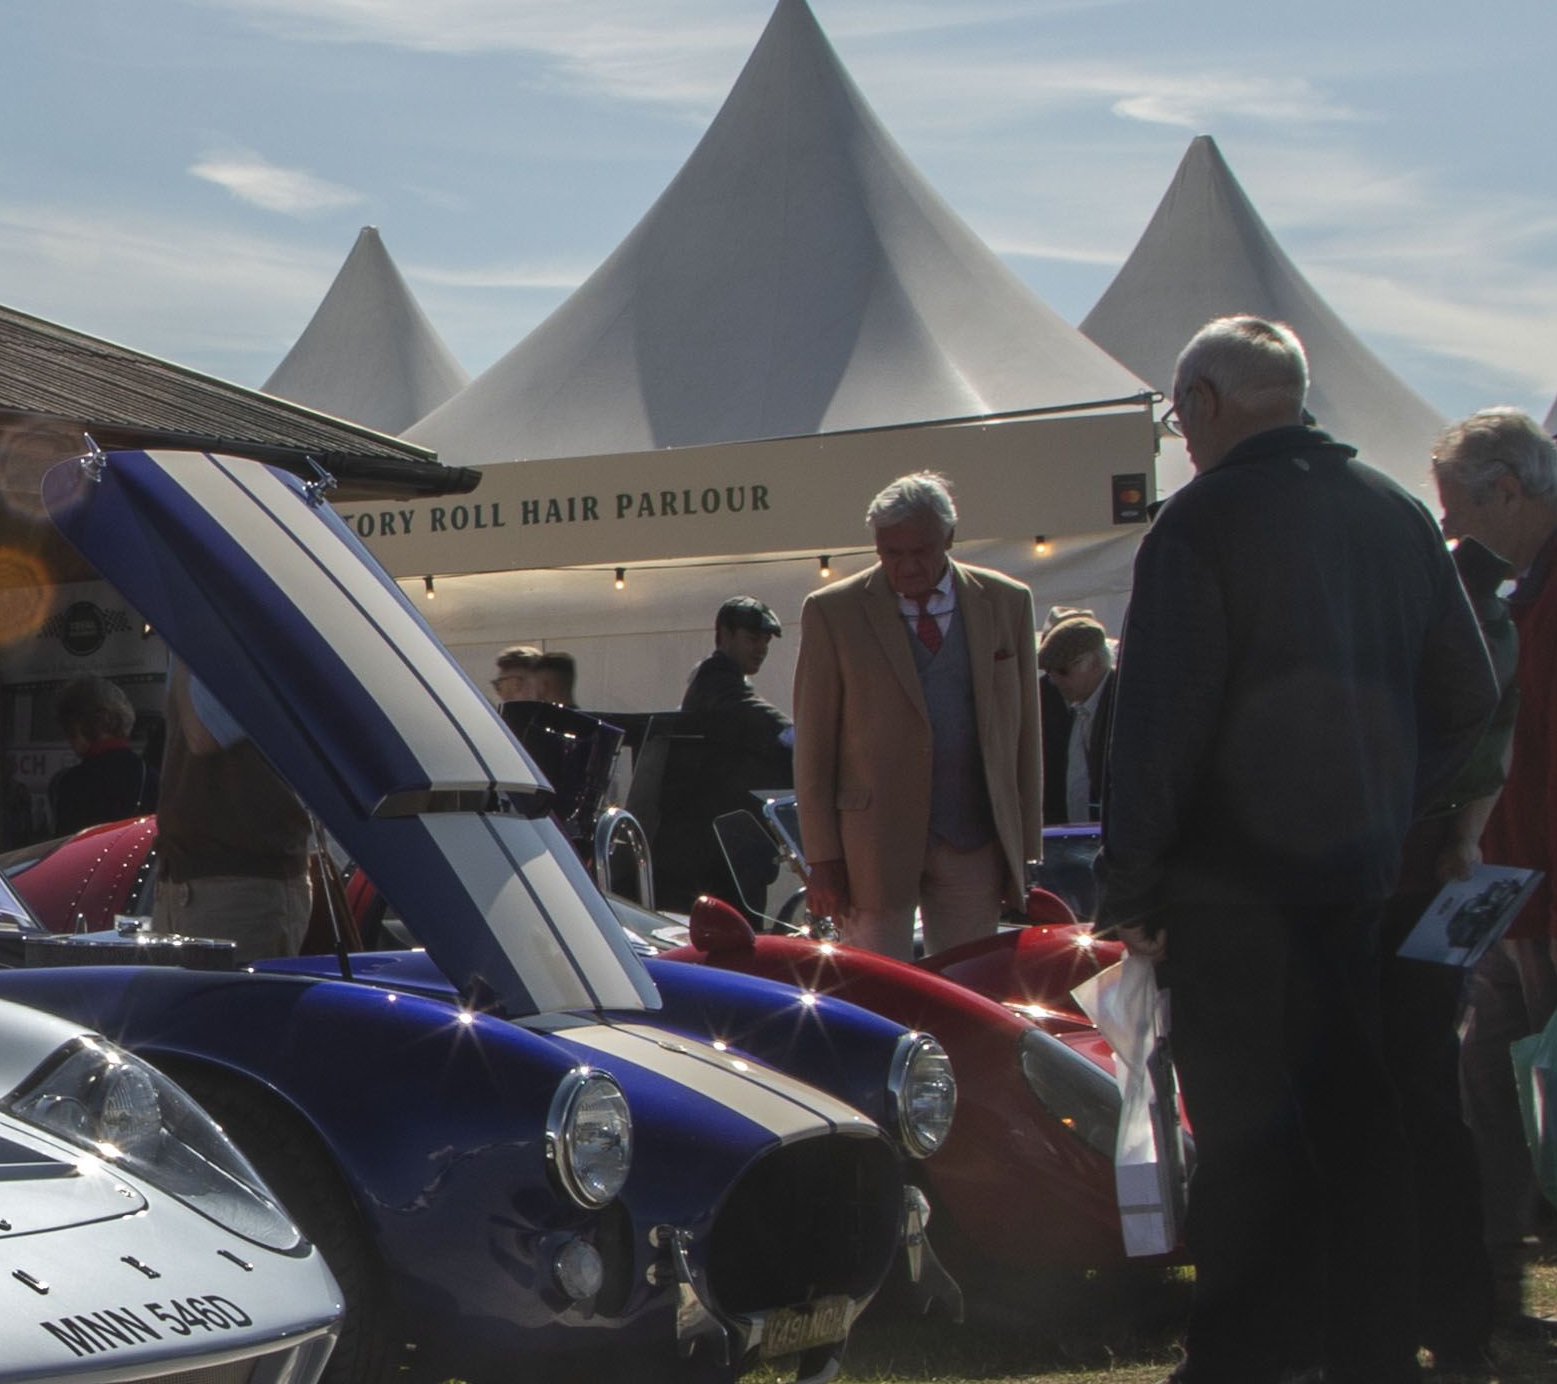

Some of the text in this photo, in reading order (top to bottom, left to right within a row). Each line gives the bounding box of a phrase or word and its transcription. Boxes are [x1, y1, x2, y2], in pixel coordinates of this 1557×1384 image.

[430, 503, 505, 533] ROLL
[521, 495, 600, 525] HAIR
[616, 485, 771, 519] PARLOUR
[39, 1294, 253, 1358] MNN 546D
